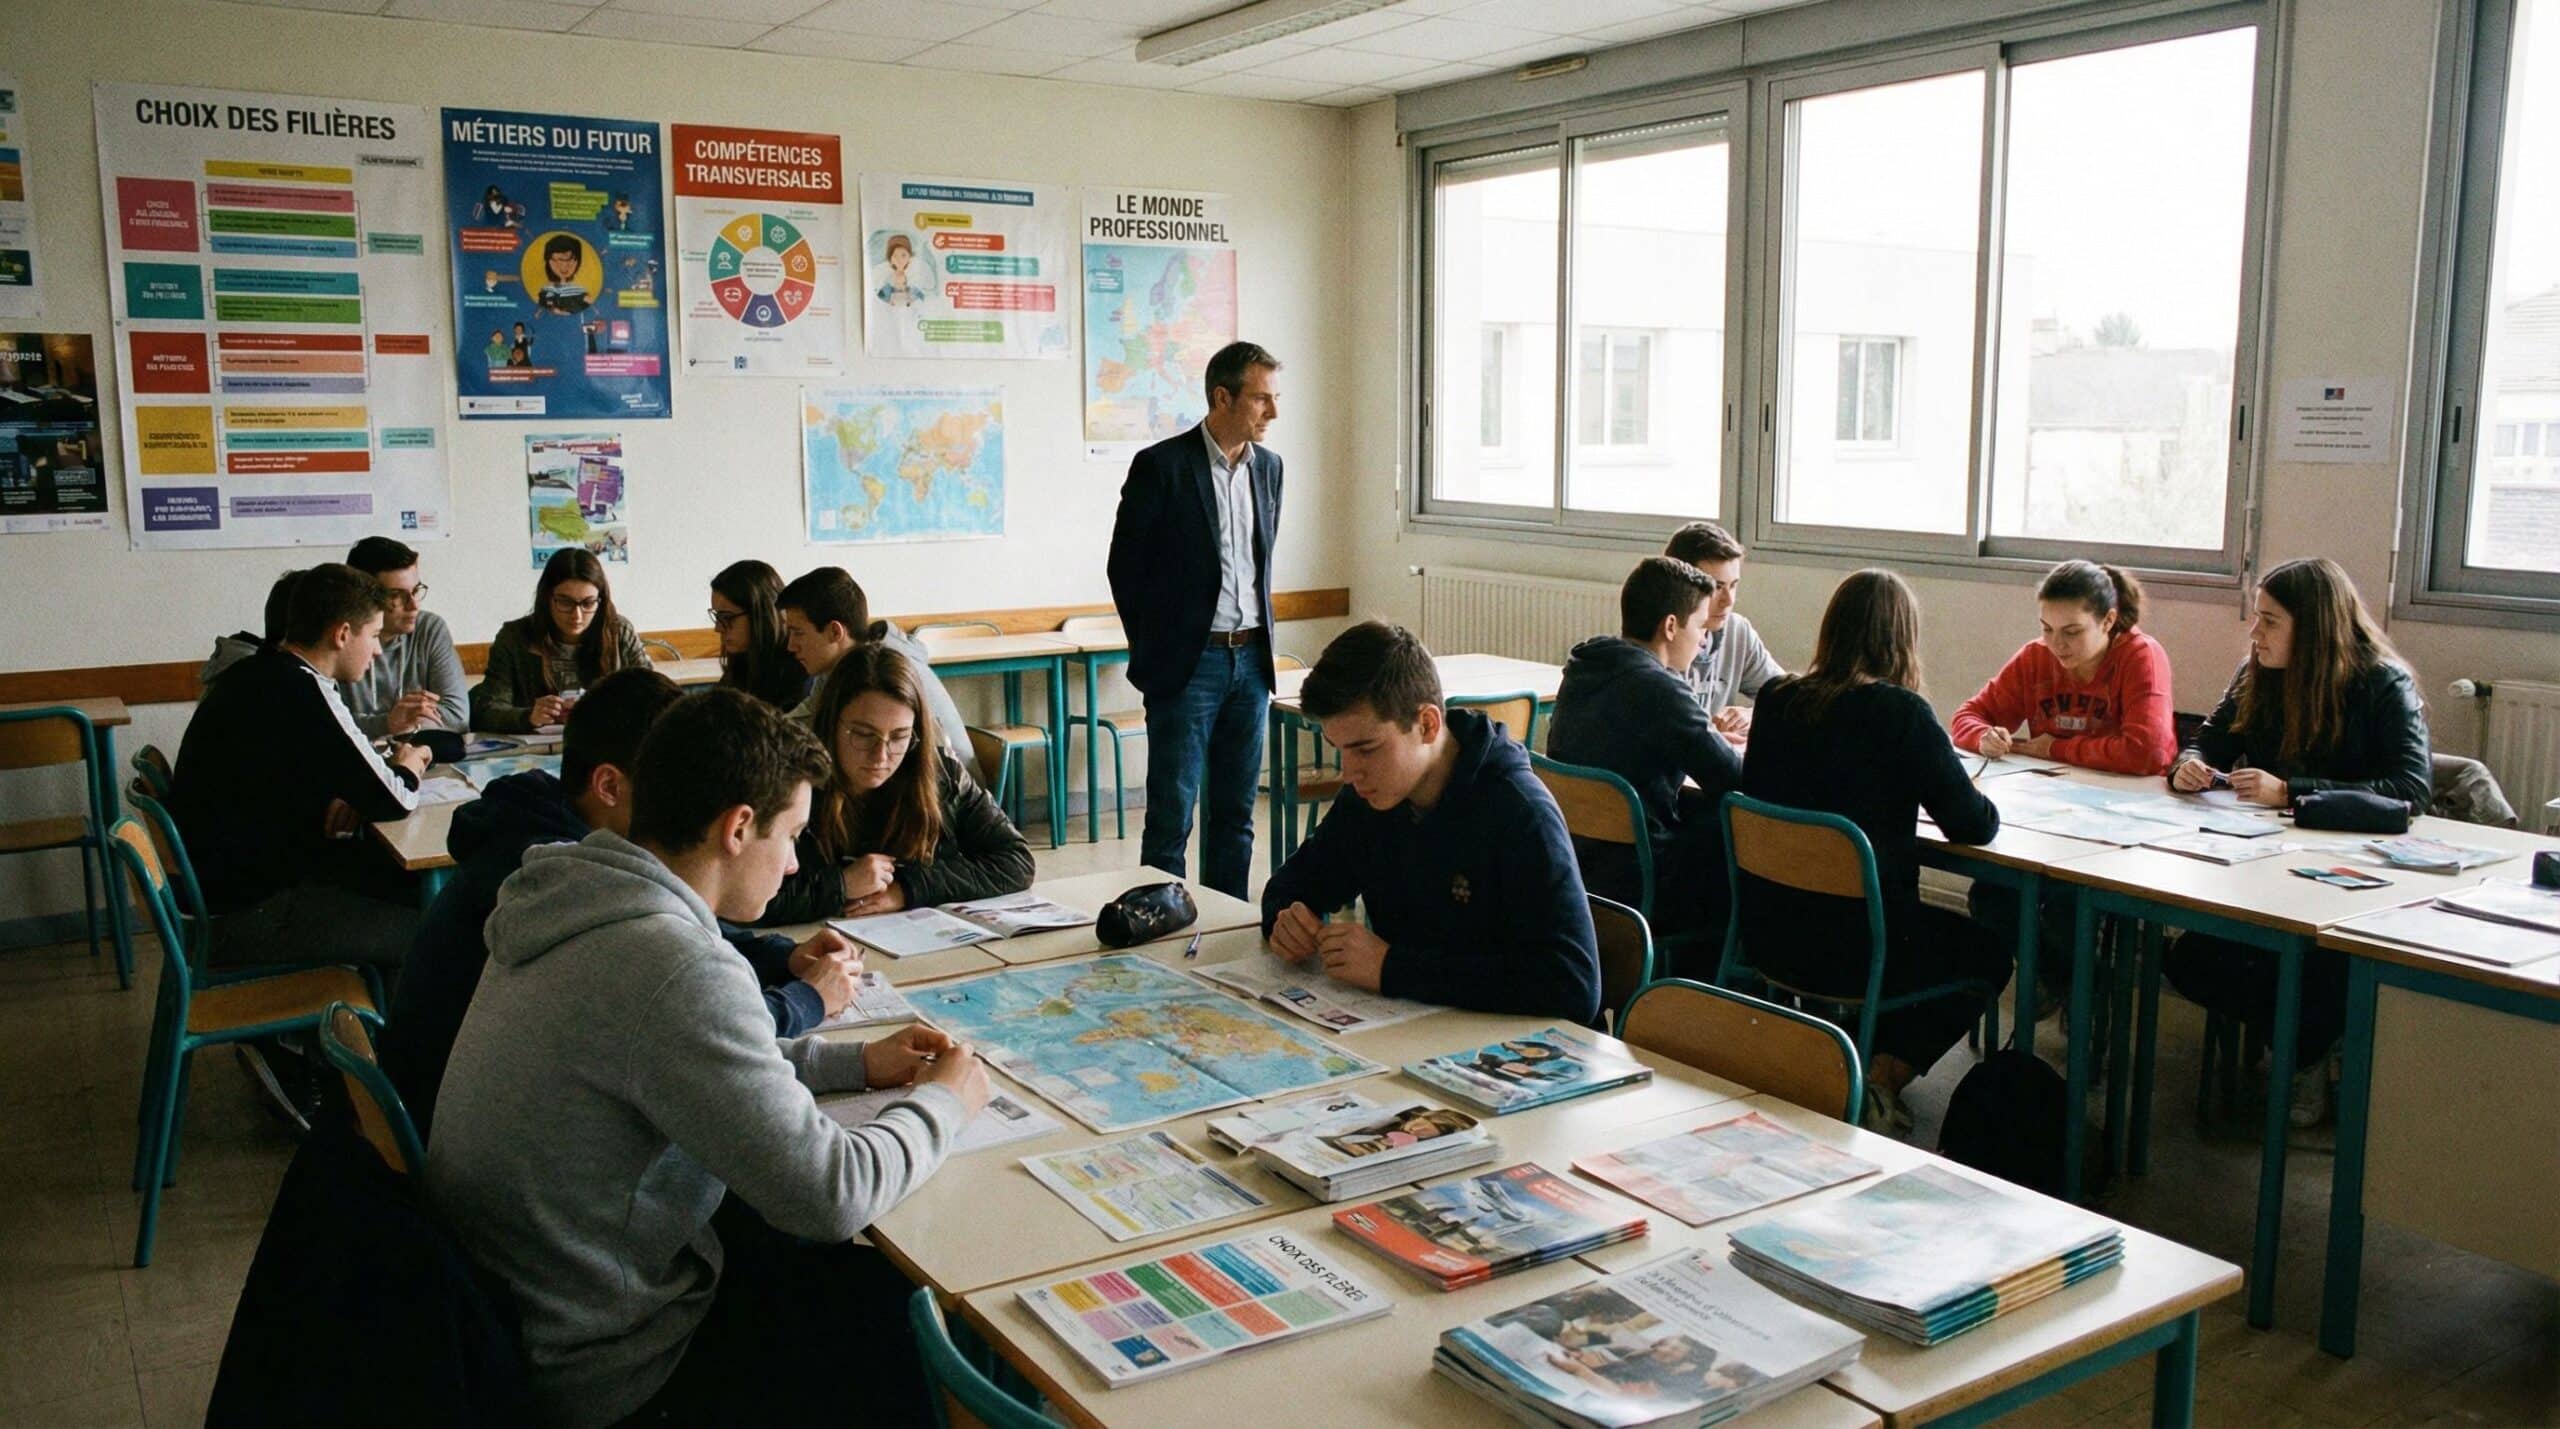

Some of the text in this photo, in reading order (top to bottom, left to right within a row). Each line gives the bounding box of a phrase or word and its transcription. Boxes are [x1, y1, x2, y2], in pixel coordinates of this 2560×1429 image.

[136, 98, 396, 141] CHOIX DES FILIÈRES
[452, 116, 652, 154] MÉTIERS DU FUTUR
[695, 138, 822, 167] COMPÉTENCES
[685, 163, 833, 190] TRANSVERSALES
[1116, 194, 1204, 218] LE MONDE
[1090, 217, 1229, 243] PROFESSIONNEL
[1268, 1234, 1306, 1260] CHOIX
